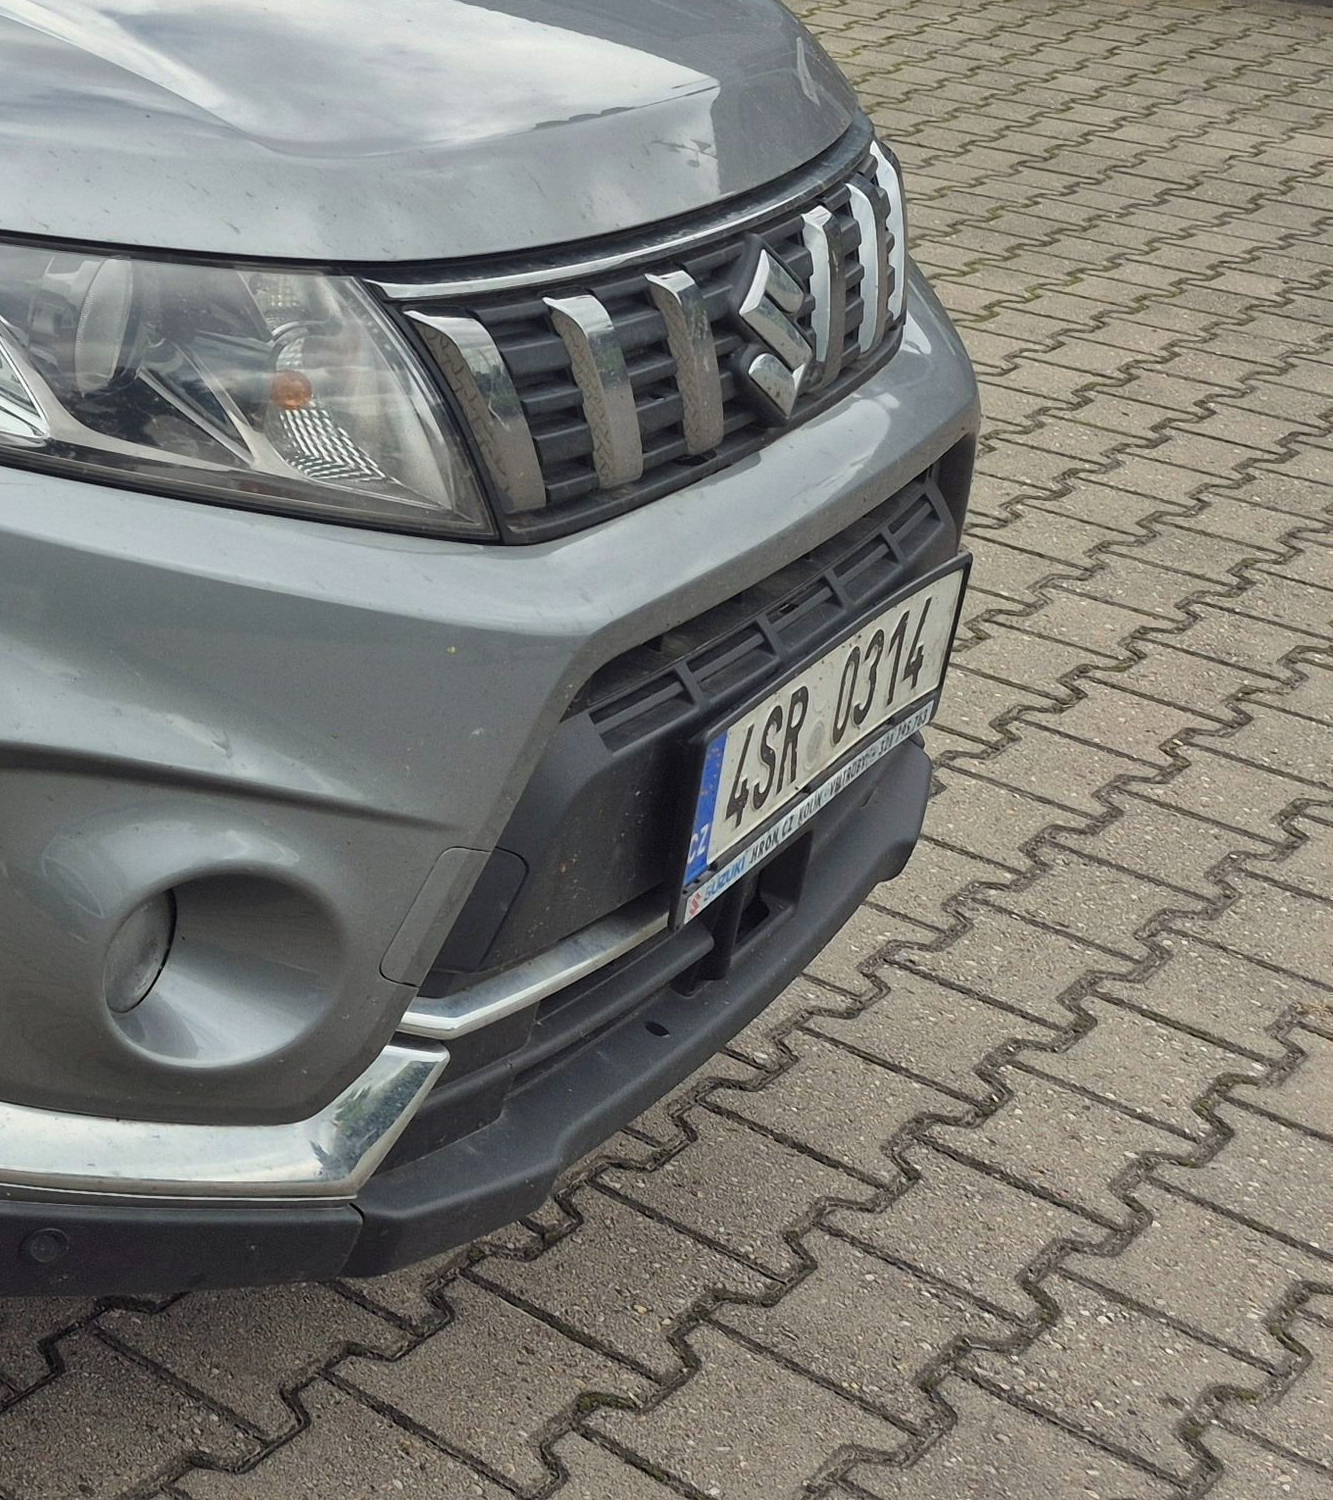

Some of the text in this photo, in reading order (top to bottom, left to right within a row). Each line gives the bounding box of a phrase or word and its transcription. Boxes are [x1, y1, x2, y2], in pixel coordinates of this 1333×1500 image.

[687, 596, 933, 864] CZ 4SR 0314
[703, 857, 746, 901] SUZUKI
